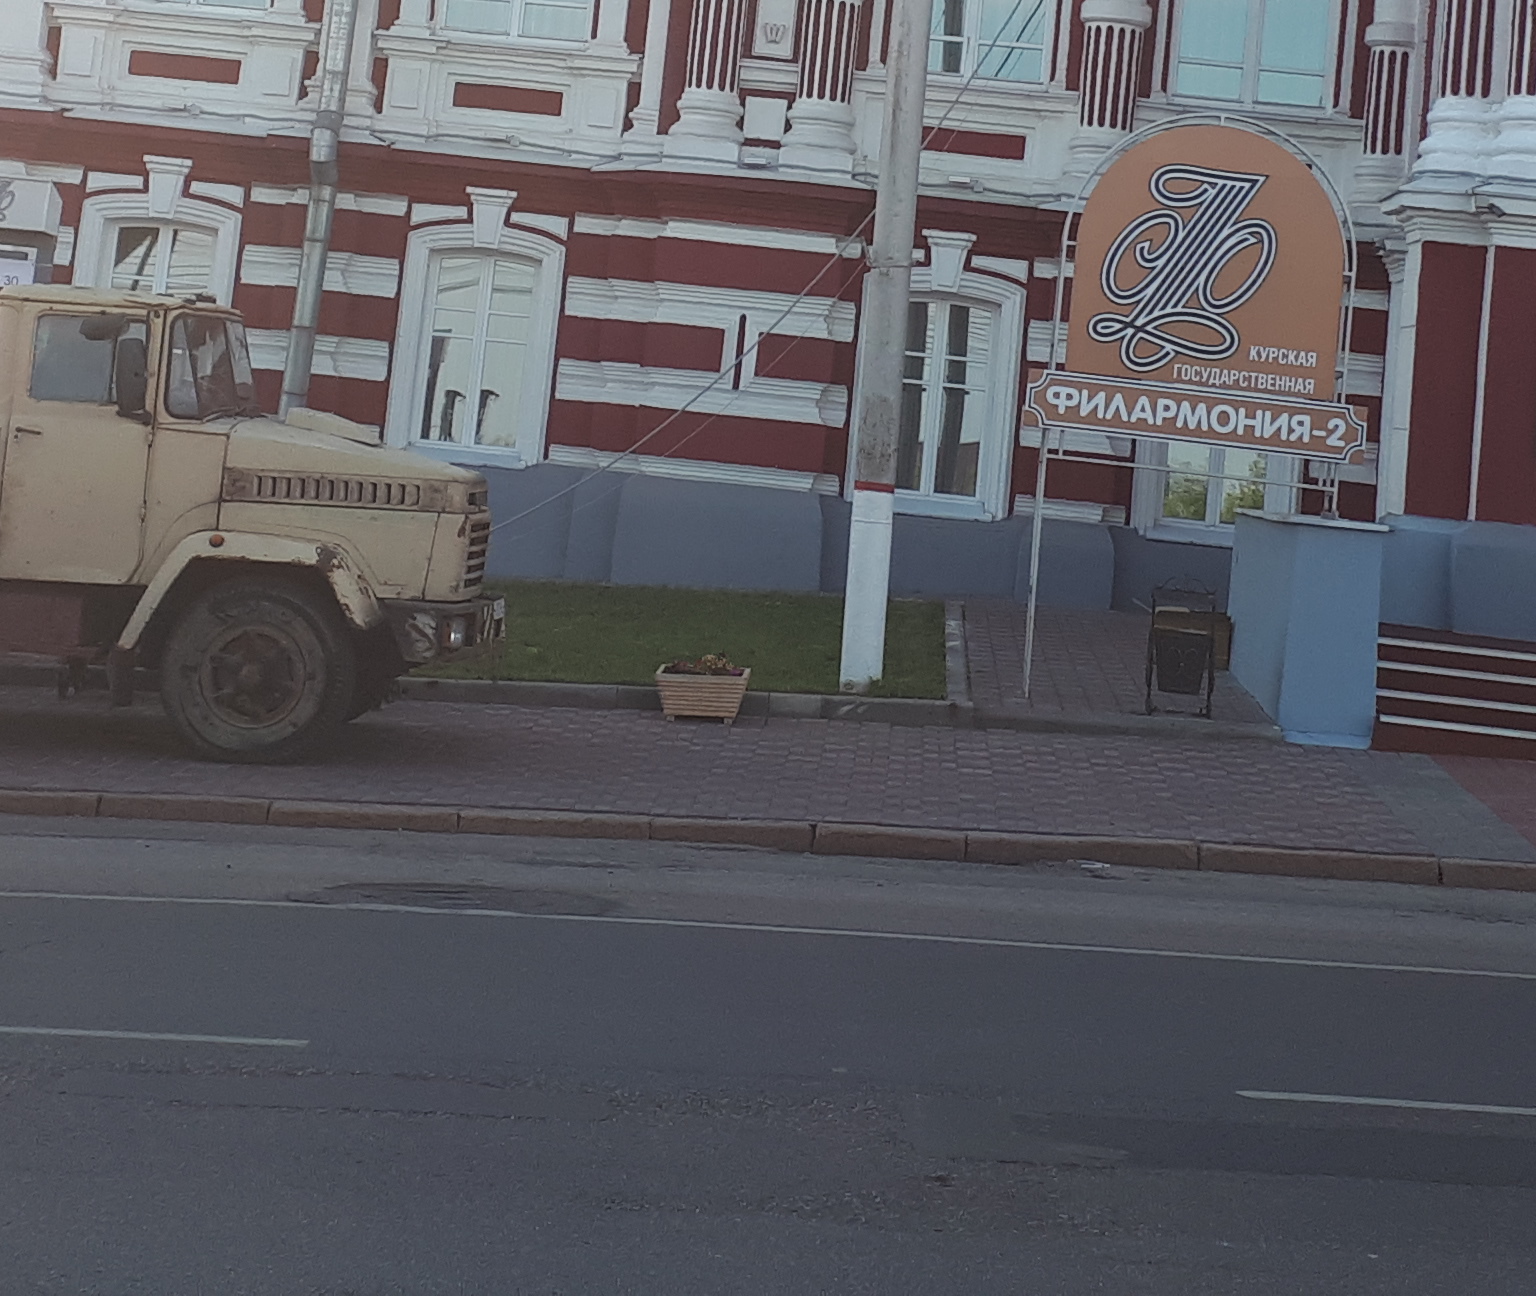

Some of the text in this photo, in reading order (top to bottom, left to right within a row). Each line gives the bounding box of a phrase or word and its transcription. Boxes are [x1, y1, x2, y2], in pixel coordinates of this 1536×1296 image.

[1249, 345, 1317, 368] КУРСКАЯ
[1172, 363, 1315, 395] ГОСУДАРСТВЕННАЯ
[1045, 385, 1347, 448] ФИЛАРМОНИЯ-2
